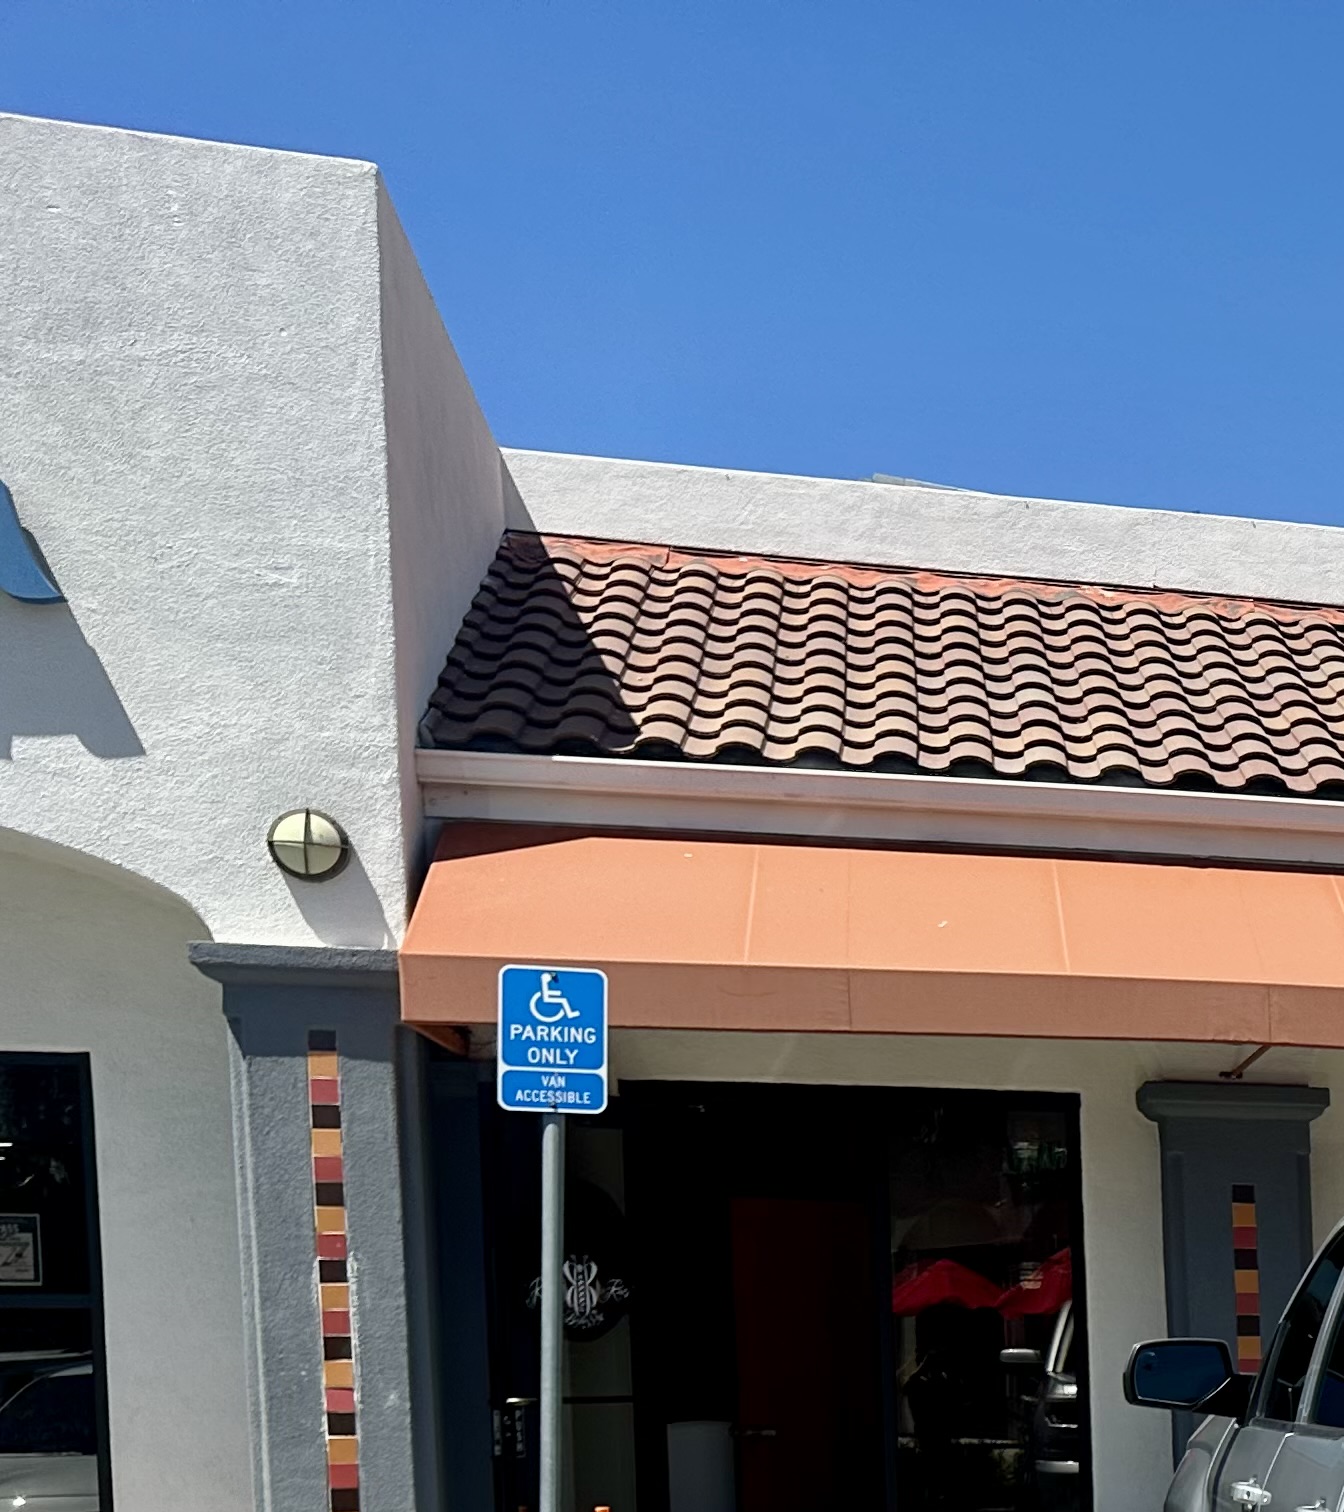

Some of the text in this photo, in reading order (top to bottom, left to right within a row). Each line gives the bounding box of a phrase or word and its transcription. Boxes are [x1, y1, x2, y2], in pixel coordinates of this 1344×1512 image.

[509, 1023, 597, 1044] PARKING
[527, 1047, 579, 1065] ONLY
[541, 1075, 566, 1088] VAN
[515, 1089, 591, 1105] ACCESSIBLE
